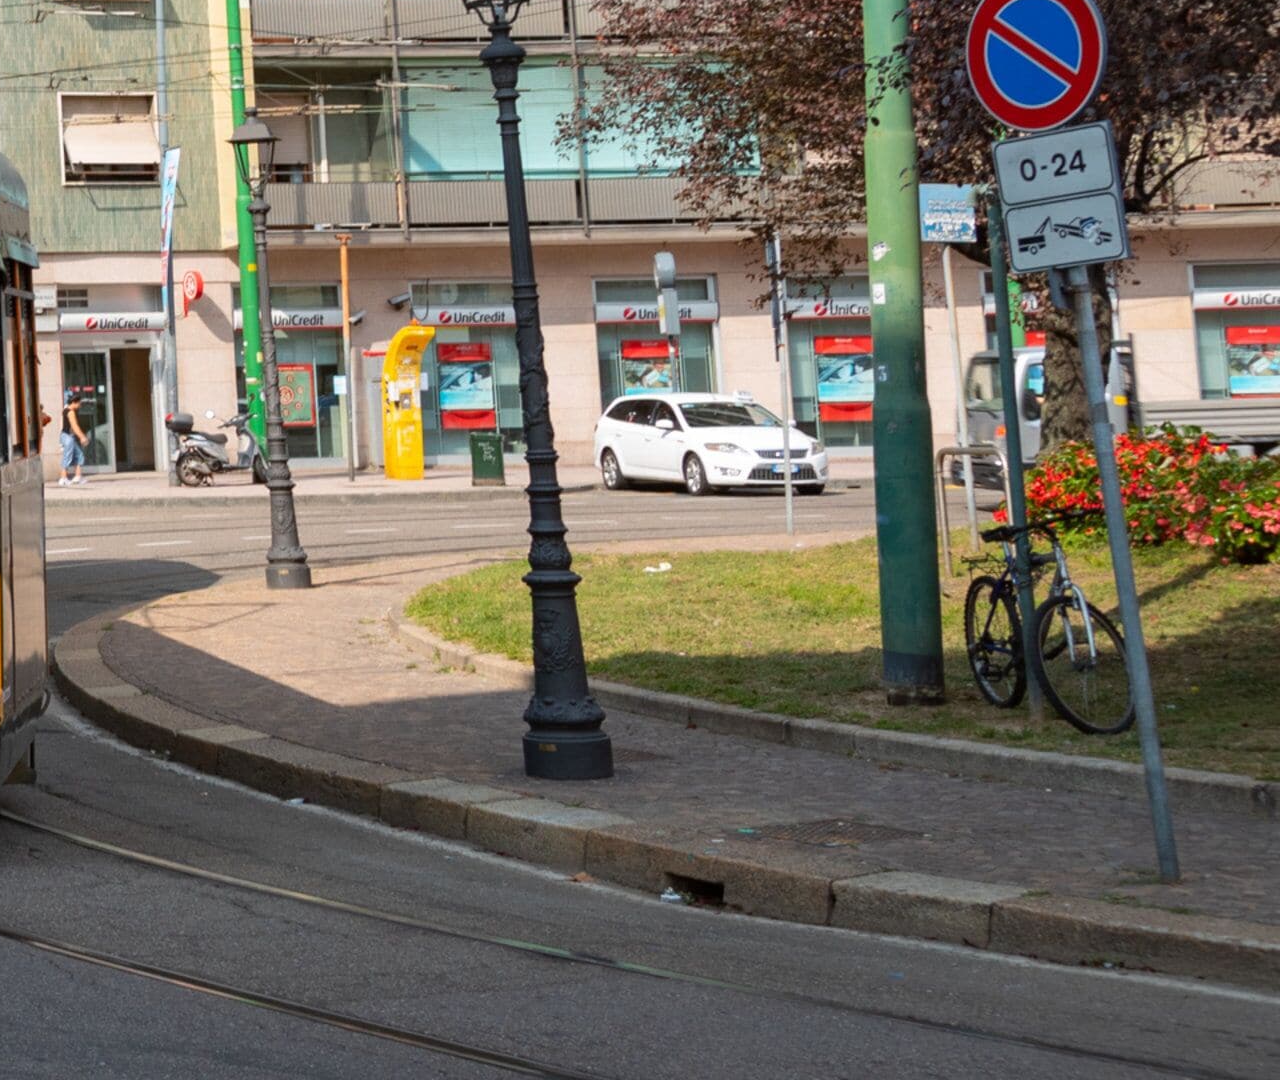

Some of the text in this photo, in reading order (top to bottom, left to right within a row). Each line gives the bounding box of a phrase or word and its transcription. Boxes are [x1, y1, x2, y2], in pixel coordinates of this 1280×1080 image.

[1020, 149, 1087, 182] 0-24
[273, 314, 324, 326] UniCredit
[453, 310, 506, 323] UniCredit
[638, 307, 692, 320] Unidit
[99, 317, 149, 330] UniCredit
